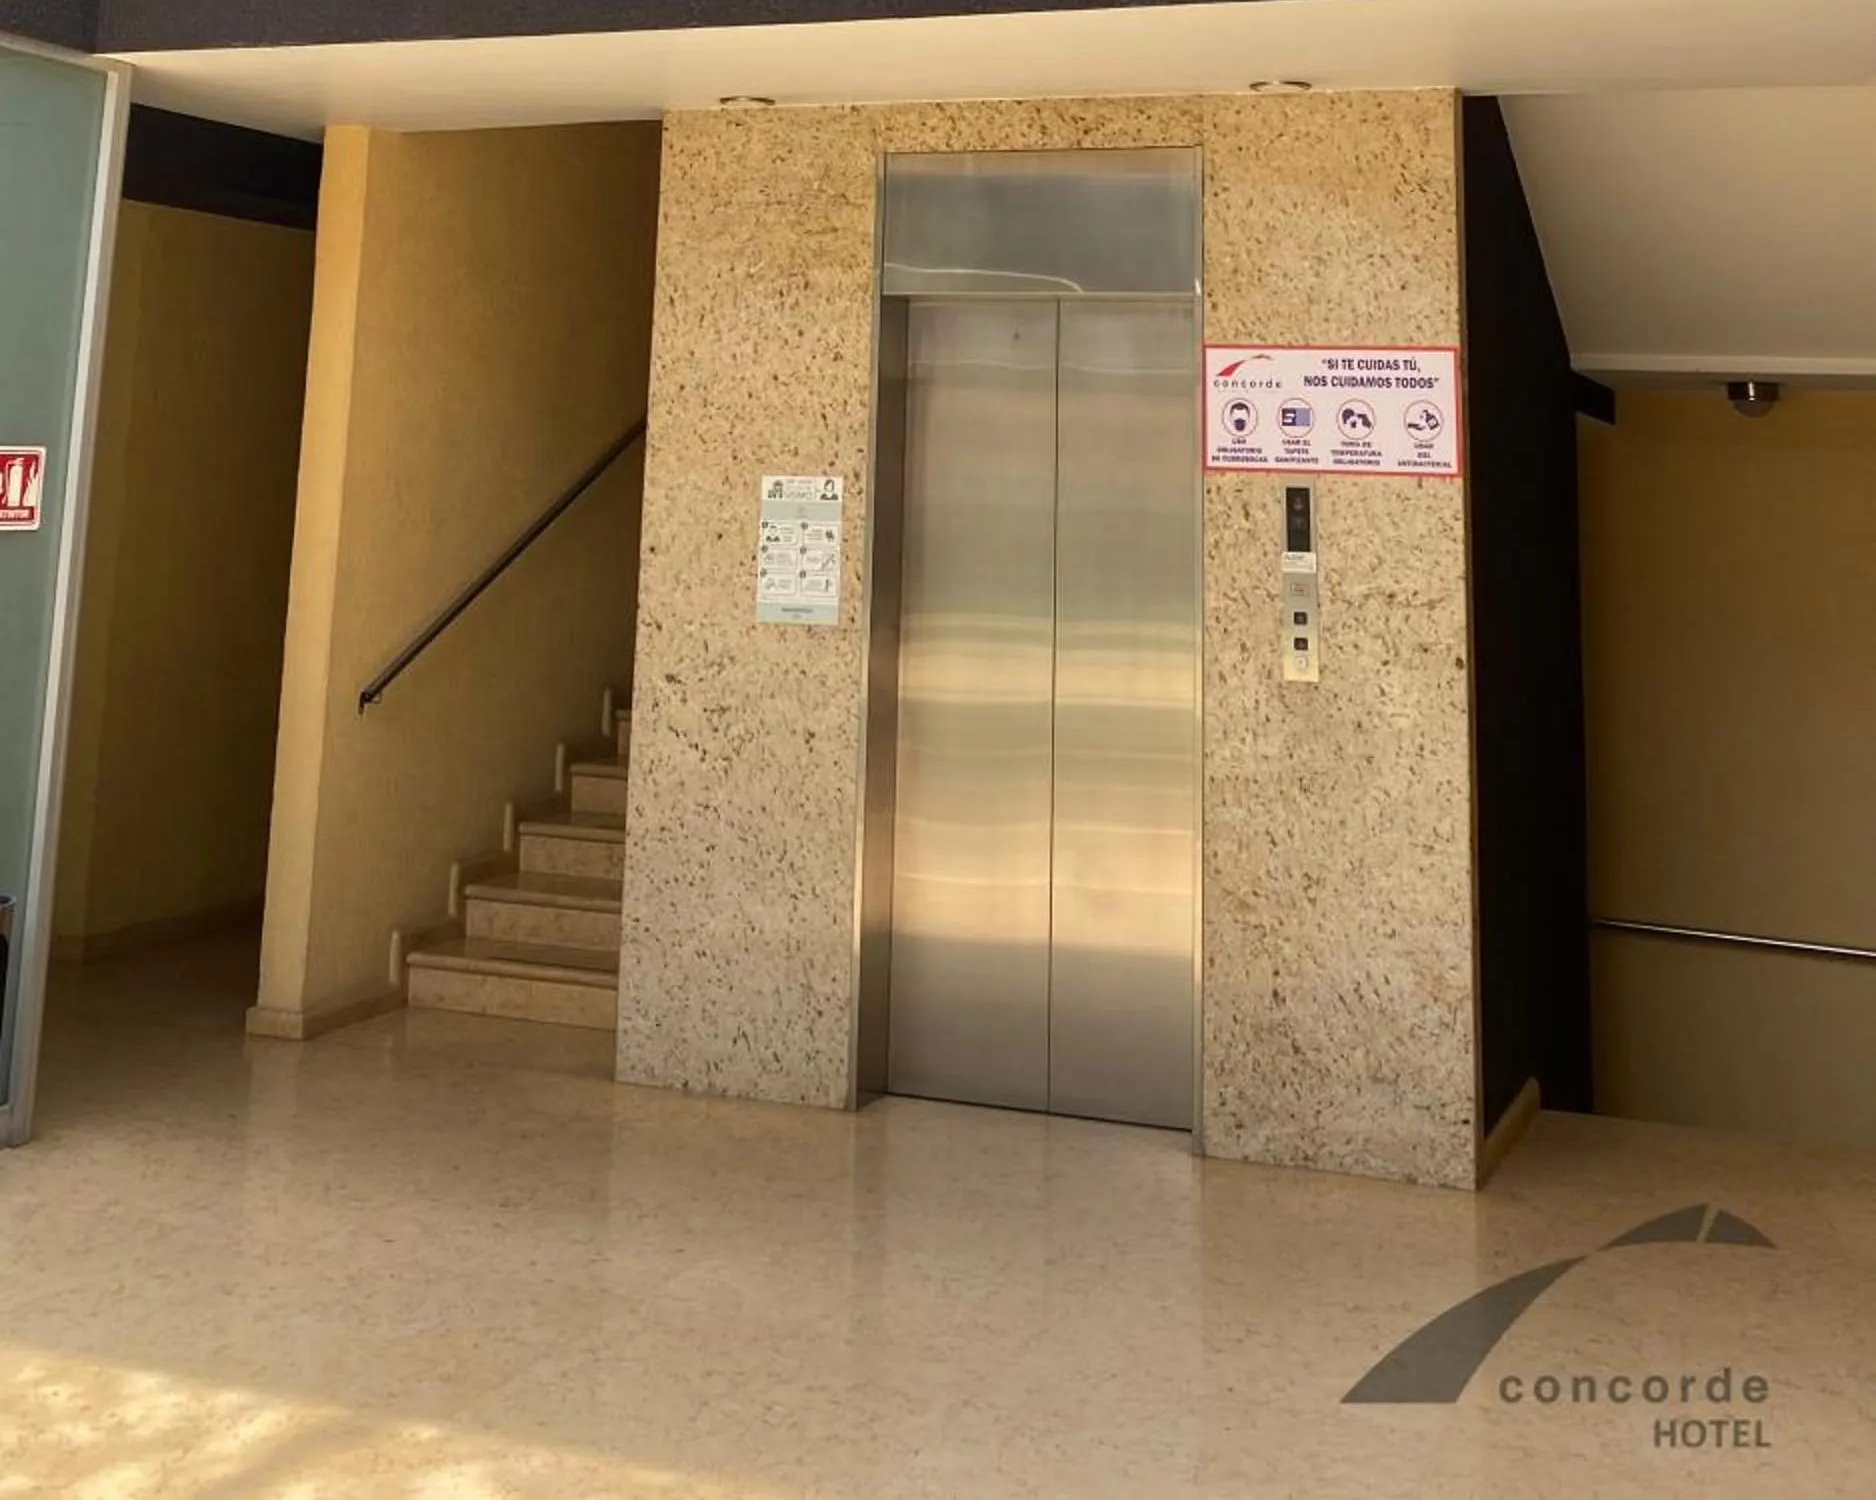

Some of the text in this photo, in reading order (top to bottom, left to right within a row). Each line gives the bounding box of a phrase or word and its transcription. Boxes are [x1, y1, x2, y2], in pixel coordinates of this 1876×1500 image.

[1341, 358, 1355, 371] TE
[1357, 358, 1401, 371] CUIDAS
[1402, 356, 1421, 373] TÚ,
[1212, 378, 1283, 389] concorde
[1303, 375, 1329, 388] NOS
[1331, 376, 1393, 389] CUIDAMOS
